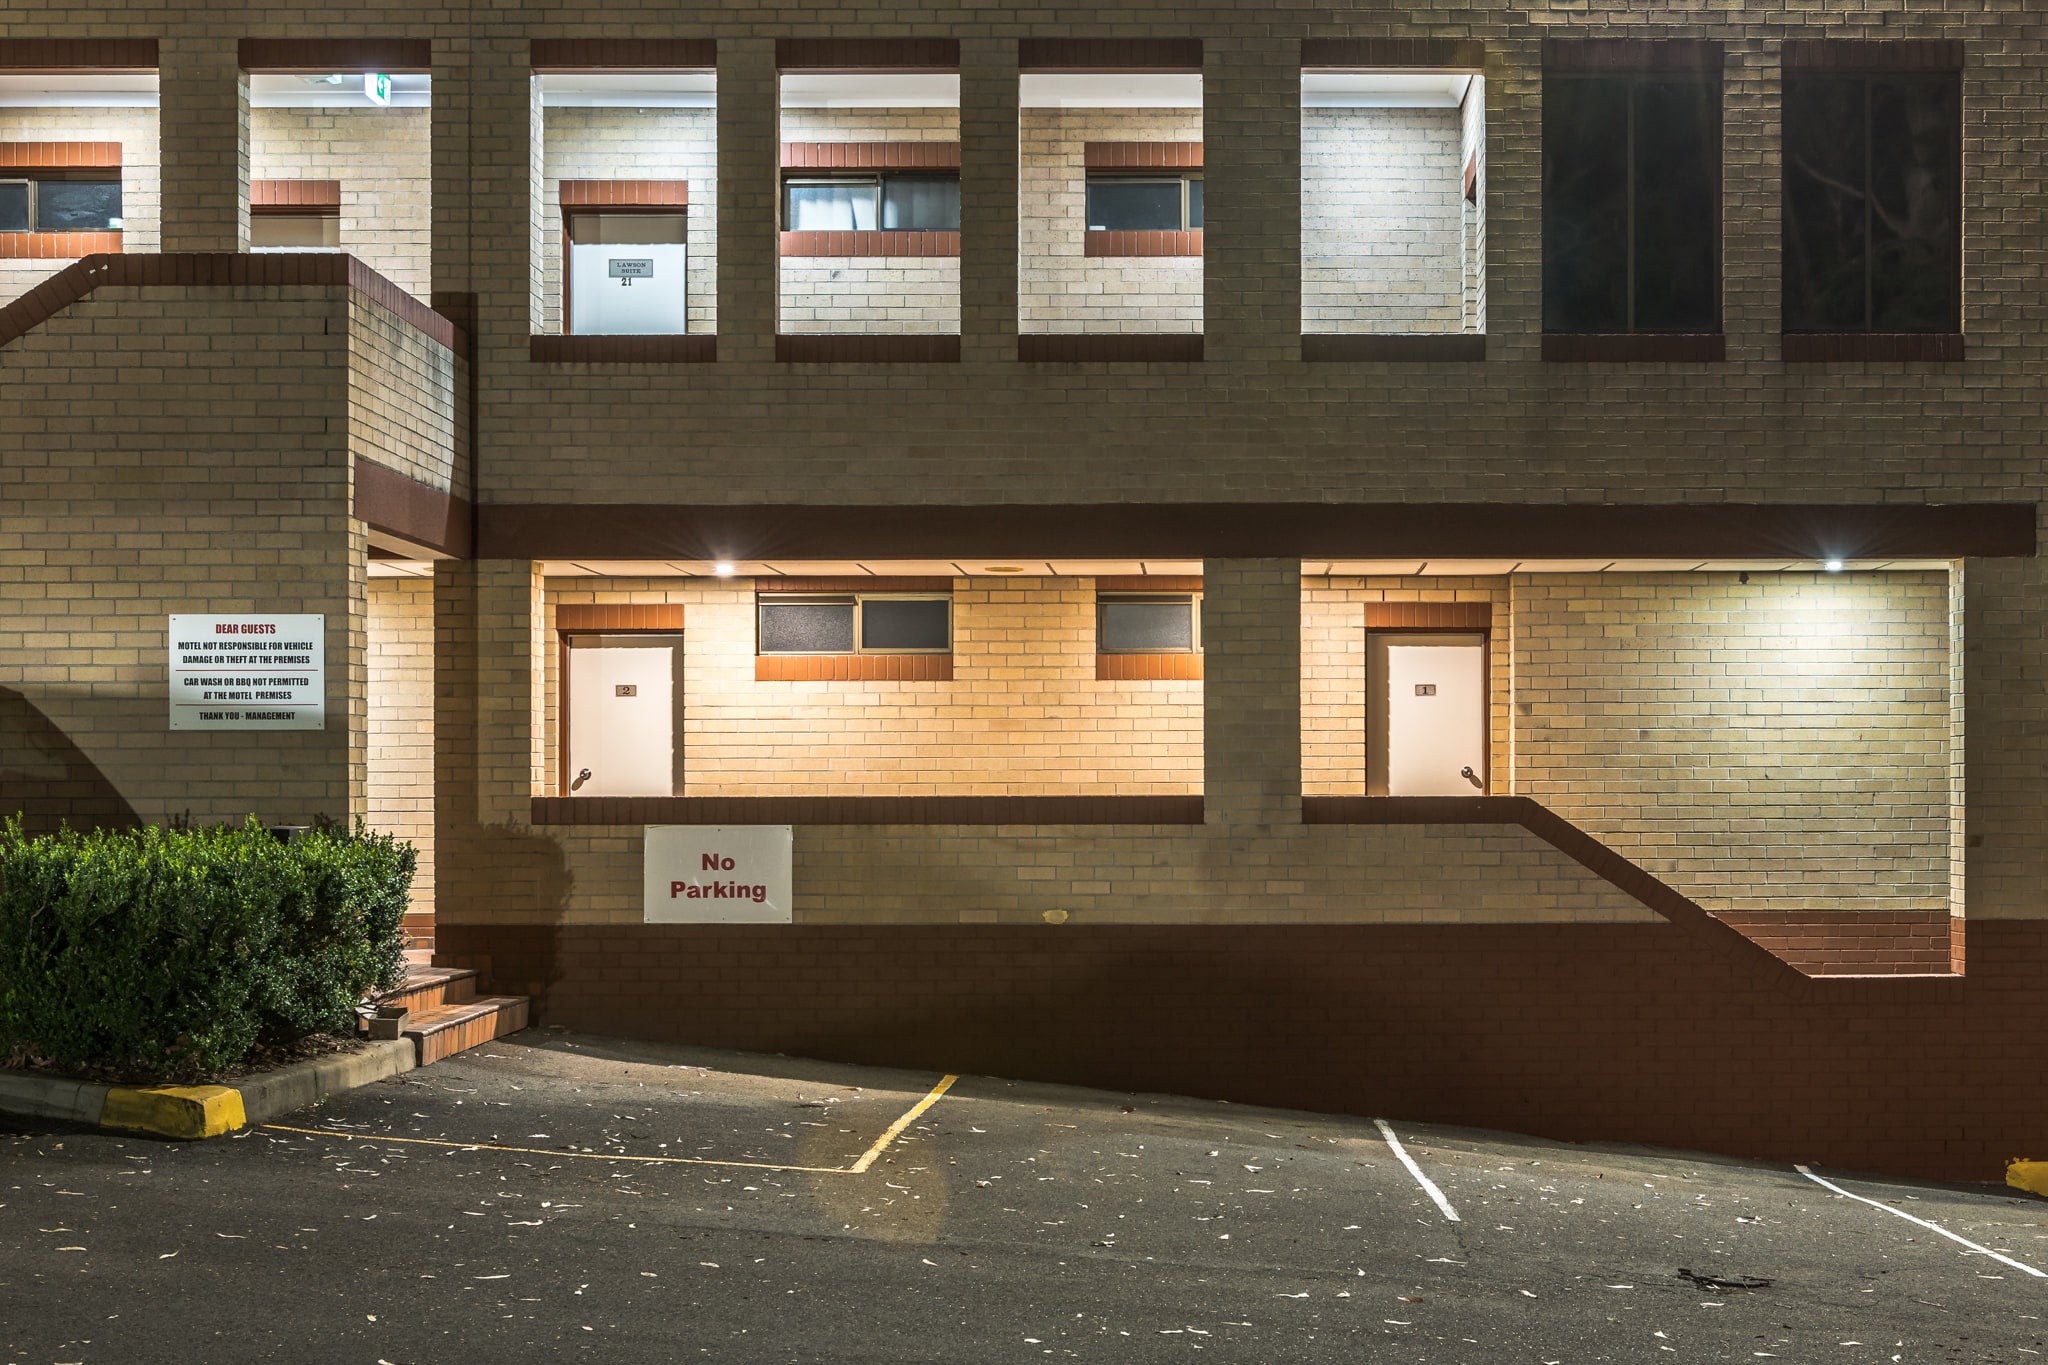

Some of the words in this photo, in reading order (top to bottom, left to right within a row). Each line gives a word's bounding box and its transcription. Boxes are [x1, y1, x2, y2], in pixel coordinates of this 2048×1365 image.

[621, 277, 632, 286] 21
[215, 623, 239, 634] DEAR
[241, 623, 276, 635] GUESTS
[178, 642, 201, 650] MOTEL
[203, 642, 217, 650] NOT
[219, 642, 267, 650] RESPONSIBLE
[269, 642, 282, 650] FOR
[284, 642, 313, 650] VEHICLE
[182, 655, 214, 664] DAMAGE
[214, 655, 225, 664] OR
[226, 655, 248, 664] THEFT
[248, 655, 258, 664] AT
[259, 655, 272, 664] THE
[274, 655, 311, 664] PREMISES
[184, 677, 199, 686] CAR
[200, 677, 222, 686] WASH
[224, 677, 234, 686] OR
[236, 677, 251, 687] BBQ
[252, 677, 267, 686] NOT
[268, 677, 309, 686] PERMITTED
[622, 686, 631, 695] 2
[1422, 686, 1429, 695] 1
[203, 691, 213, 700] AT
[214, 691, 228, 700] THE
[229, 691, 252, 700] MOTEL
[255, 691, 292, 700] PREMISES
[199, 711, 223, 720] THANK
[225, 711, 240, 720] YOU
[245, 711, 295, 720] MANAGEMENT
[702, 853, 735, 871] No
[670, 881, 766, 903] Parking
